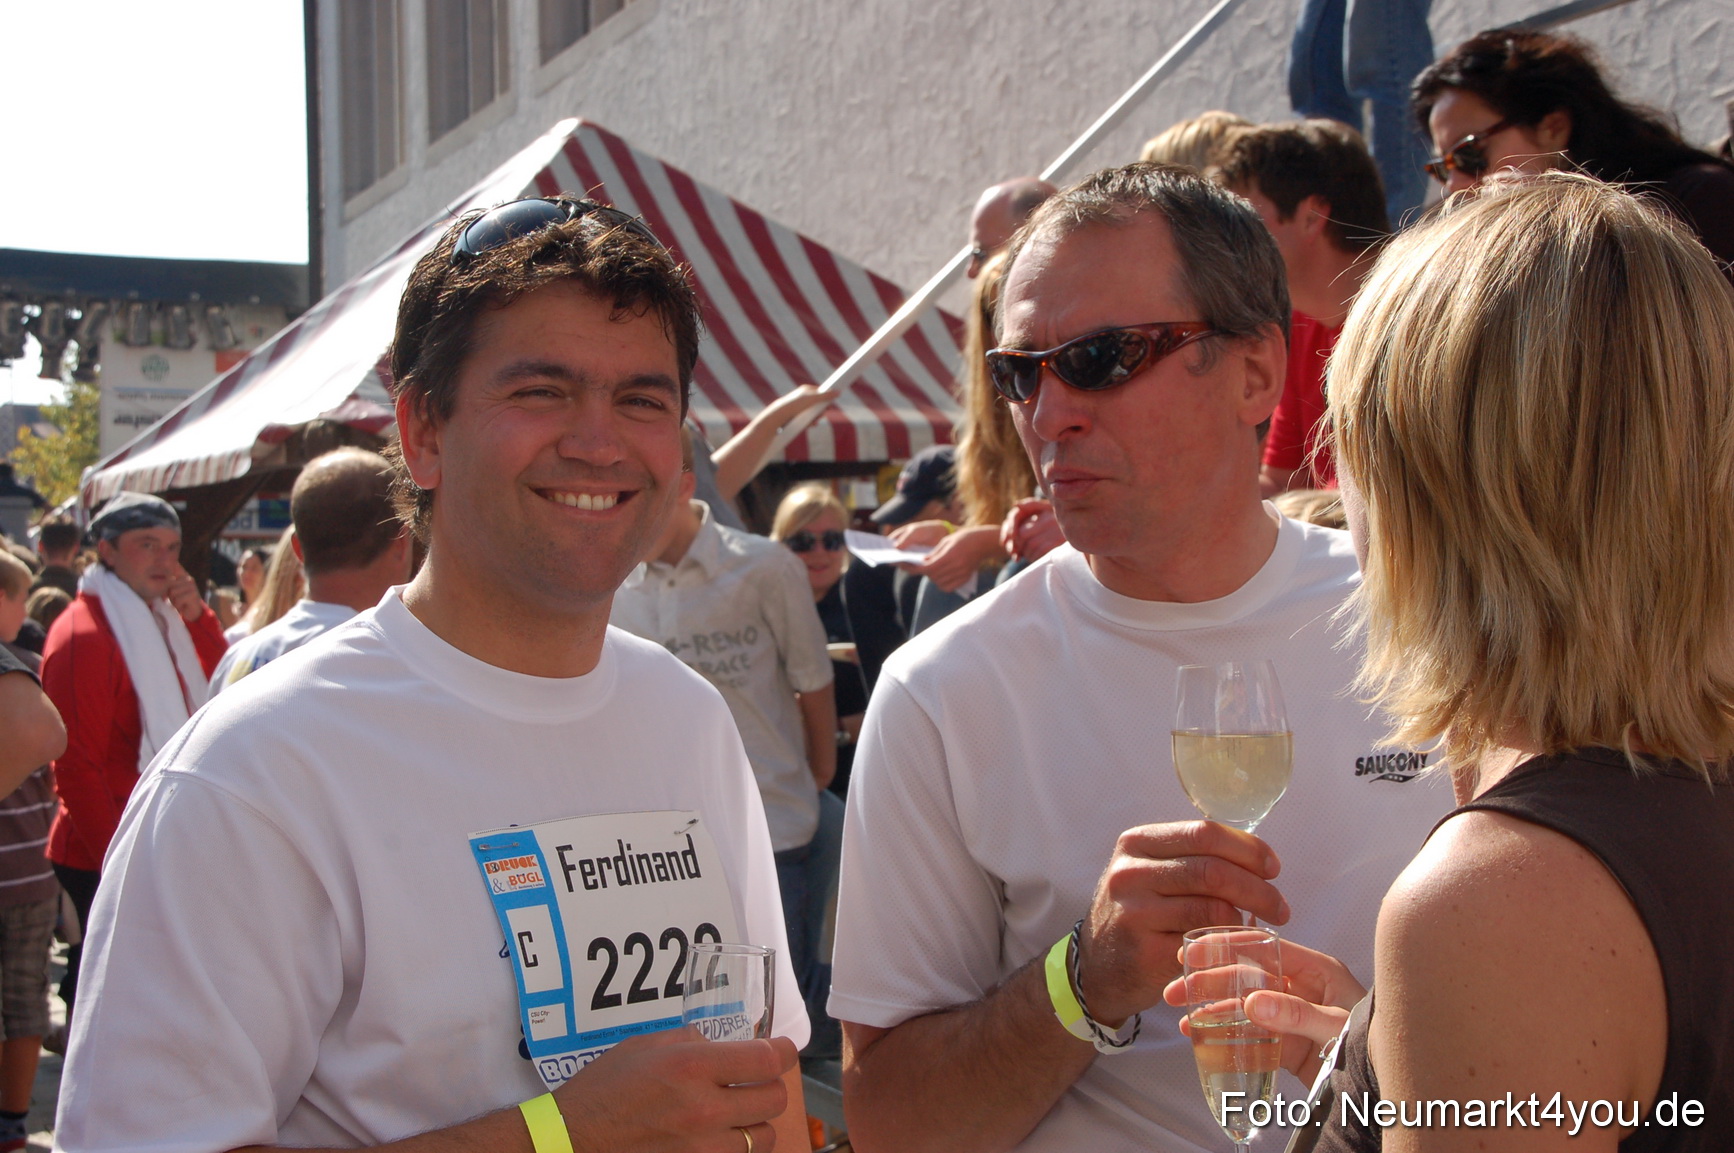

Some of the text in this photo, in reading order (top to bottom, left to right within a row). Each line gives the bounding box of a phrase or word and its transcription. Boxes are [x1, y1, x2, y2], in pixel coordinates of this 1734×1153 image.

[1354, 751, 1429, 776] SAUCONY
[508, 871, 544, 887] BÖGL
[556, 833, 702, 893] Ferdinand
[517, 930, 539, 969] C
[586, 921, 730, 1012] 2222
